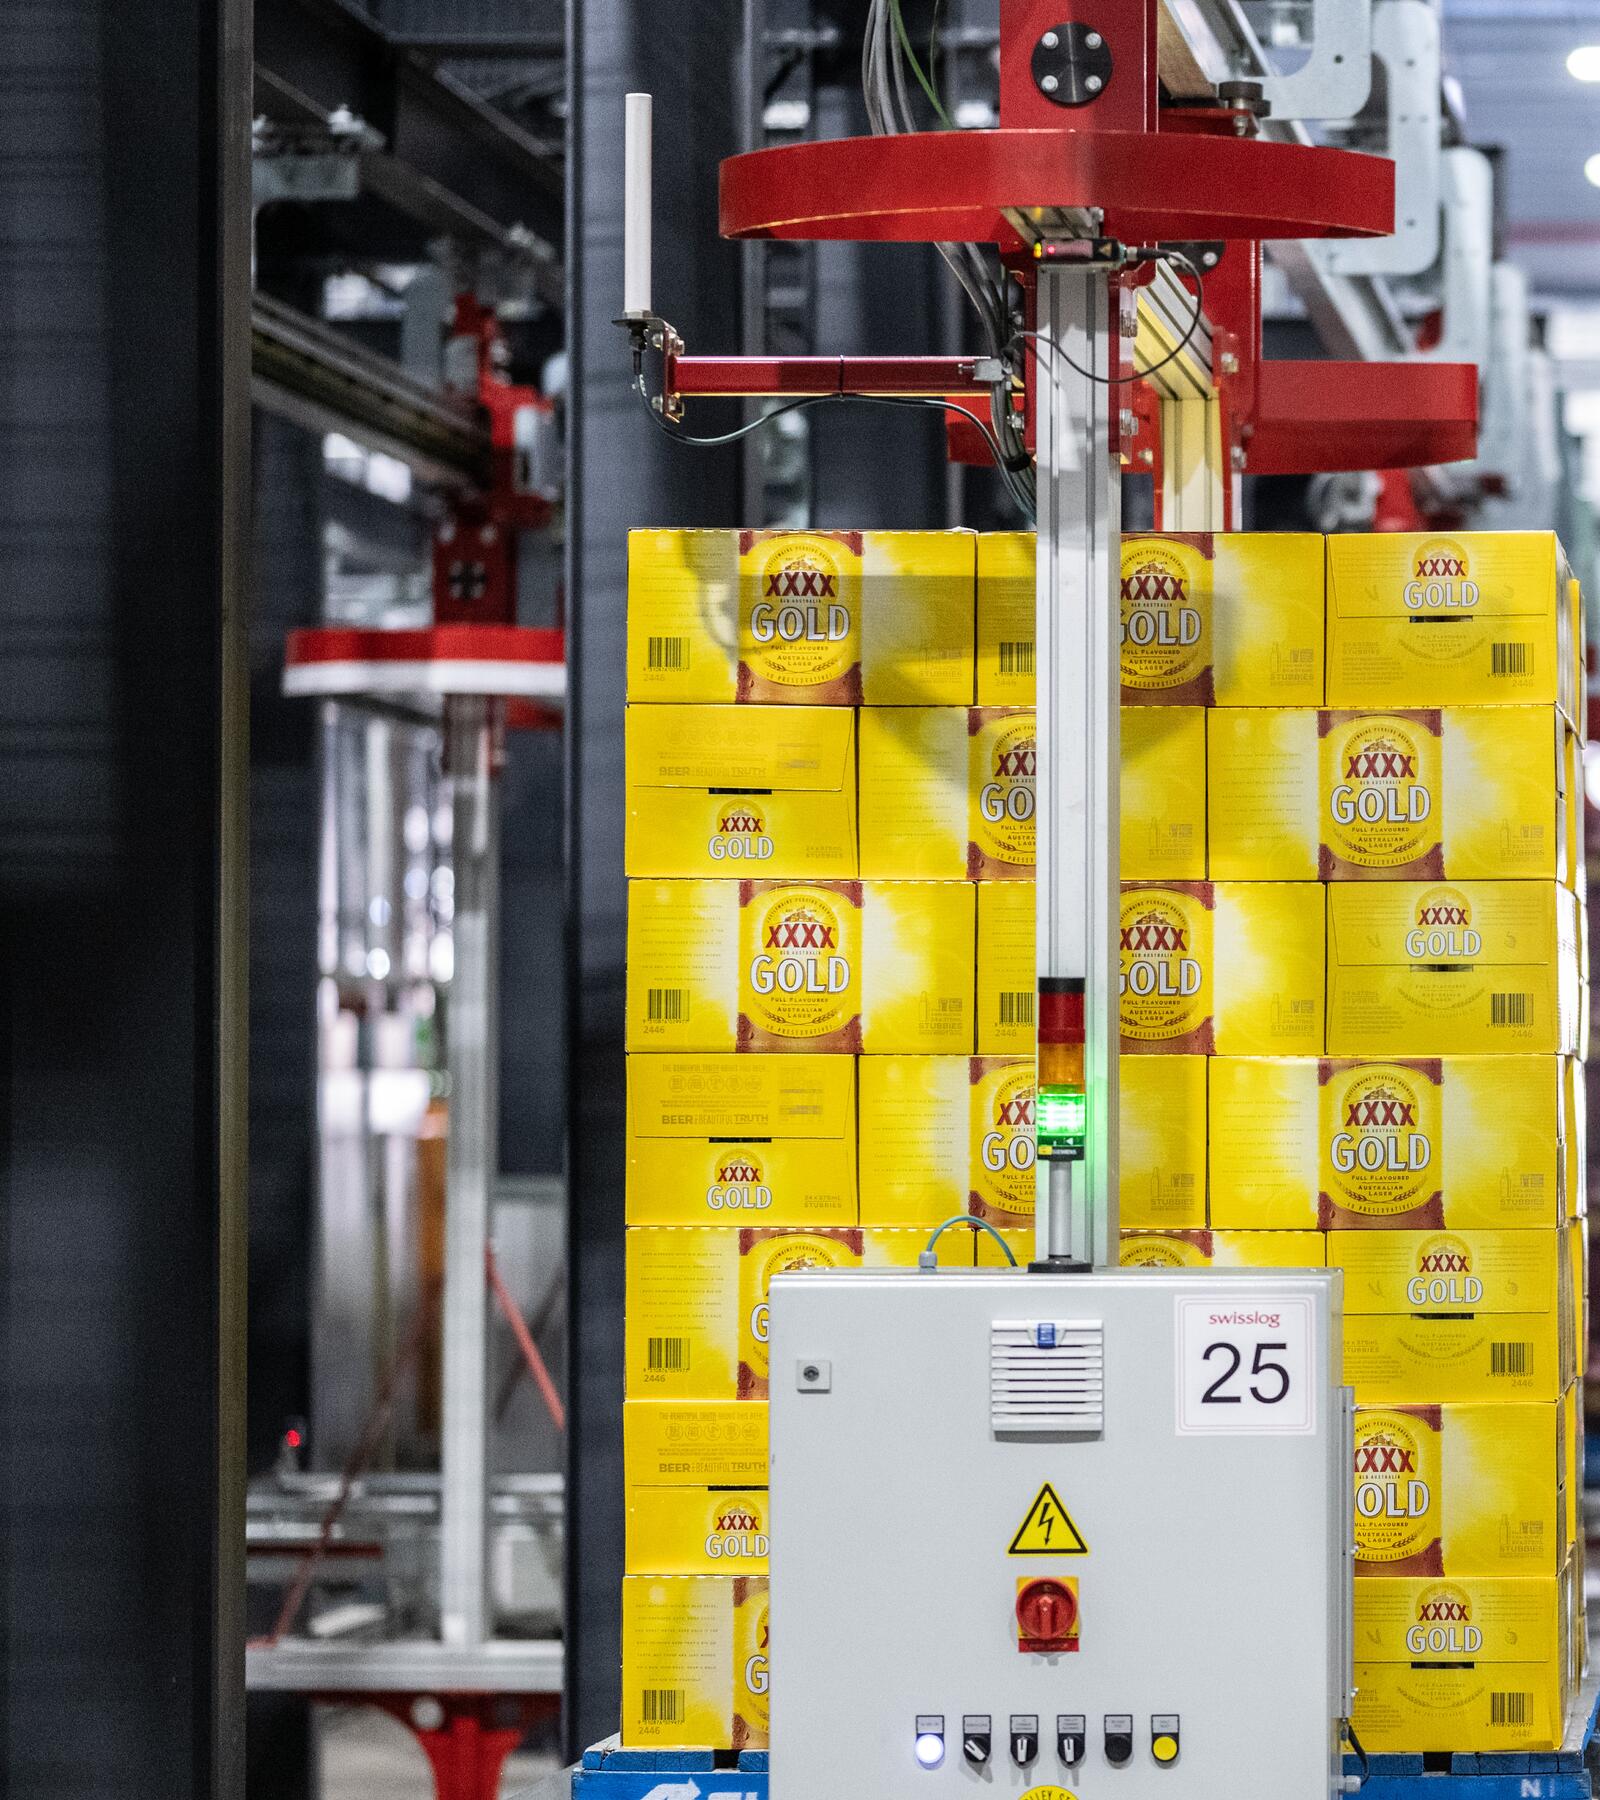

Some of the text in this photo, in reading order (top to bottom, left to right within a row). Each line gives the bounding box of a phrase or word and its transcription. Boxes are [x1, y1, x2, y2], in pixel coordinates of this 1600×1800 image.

[1416, 558, 1467, 578] XXXX
[766, 572, 837, 597] XXXX
[1403, 580, 1479, 610] GOLD
[751, 603, 851, 642] GOLD
[995, 751, 1036, 776] XX
[1345, 753, 1416, 778] XXXX
[980, 783, 1036, 822] GO
[1331, 785, 1431, 824] GOLD
[719, 816, 763, 833] XXXX
[708, 835, 774, 860] GOLD
[1418, 907, 1468, 926] XXXX
[765, 923, 836, 948] XXXX
[1405, 929, 1481, 958] GOLD
[750, 955, 850, 994] GOLD
[1121, 958, 1202, 997] OLD
[643, 1025, 665, 1034] 2446
[995, 1029, 1017, 1038] 2446
[1511, 1029, 1533, 1038] 2446
[662, 1114, 694, 1125] BEER
[734, 1114, 769, 1122] TRUTH
[996, 1100, 1035, 1125] XX
[1345, 1101, 1416, 1126] XXXX
[982, 1132, 1035, 1171] GO
[1331, 1133, 1431, 1172] GOLD
[717, 1166, 761, 1182] XXXX
[706, 1184, 772, 1210] GOLD
[1419, 1255, 1471, 1273] XXXX
[1406, 1275, 1483, 1305] GOLD
[1209, 1311, 1281, 1328] swisslog
[644, 1374, 666, 1383] 2446
[1201, 1342, 1290, 1404] 25
[1511, 1379, 1534, 1387] 2446
[659, 1463, 691, 1472] BEER
[731, 1462, 767, 1470] TRUTH
[1356, 1480, 1430, 1519] OLD
[716, 1515, 760, 1531] XXXX
[705, 1533, 770, 1559] GOLD
[1418, 1602, 1470, 1622] XXXX
[1406, 1624, 1483, 1654] GOLD
[638, 1726, 661, 1735] 2446
[1511, 1729, 1533, 1738] 2446
